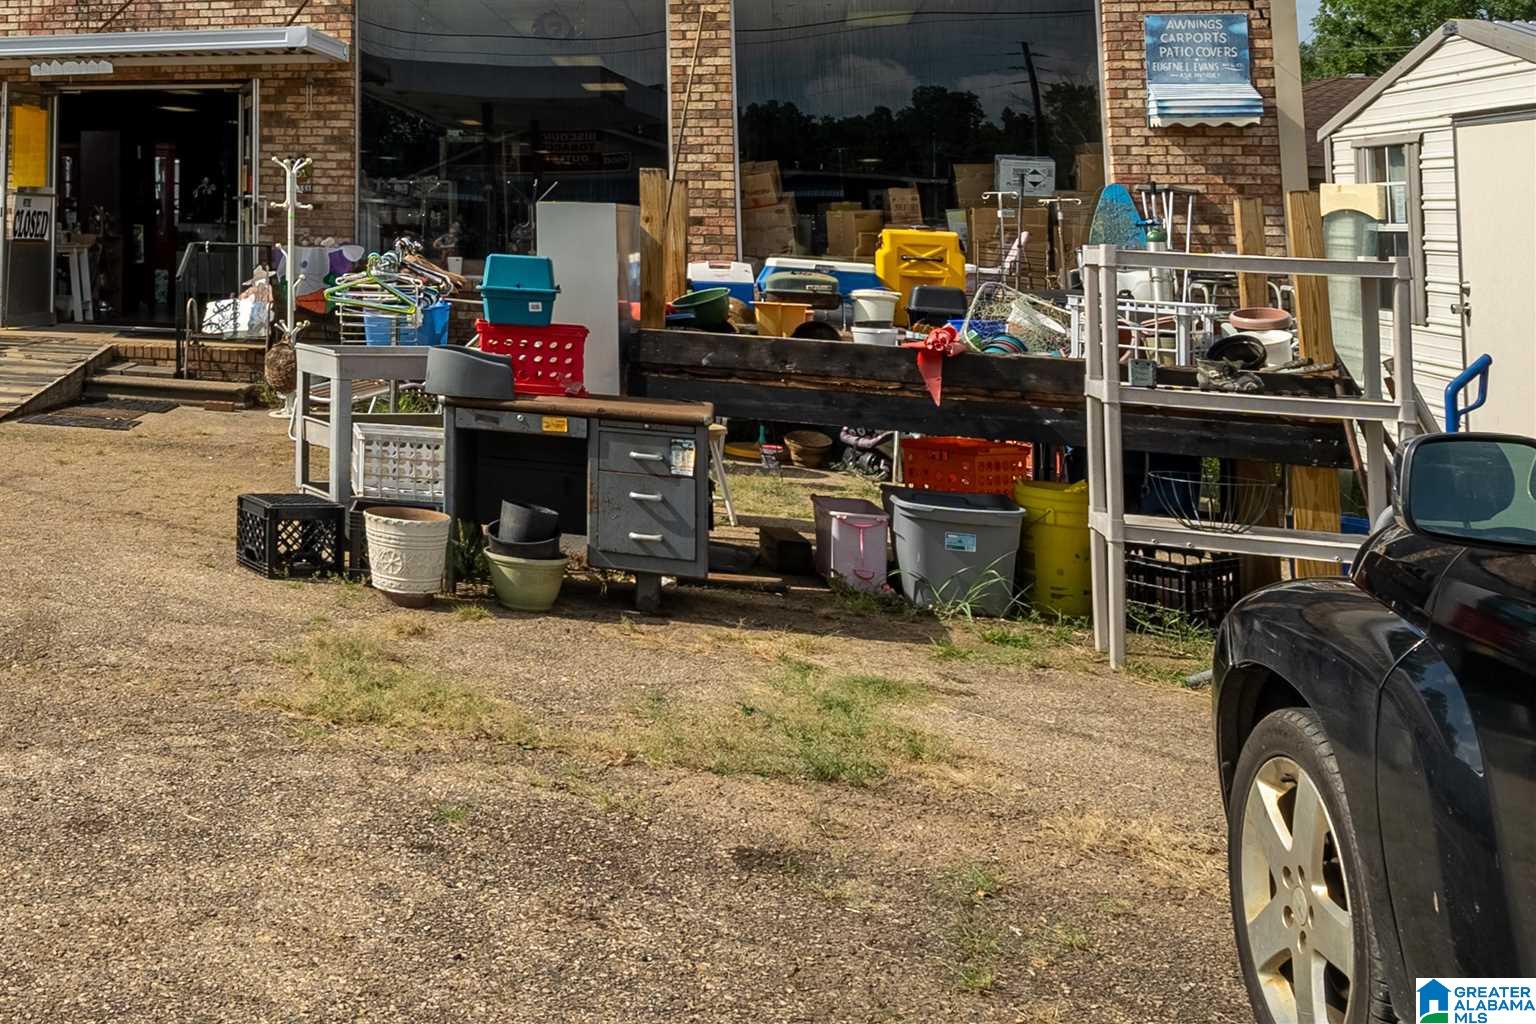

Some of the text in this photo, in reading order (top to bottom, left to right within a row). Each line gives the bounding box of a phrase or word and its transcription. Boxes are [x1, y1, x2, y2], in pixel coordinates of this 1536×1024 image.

[1166, 19, 1223, 30] AWNINGS
[1160, 32, 1227, 43] CARPORTS
[1159, 47, 1238, 57] PATIO COVERS
[14, 210, 49, 238] CLOSED
